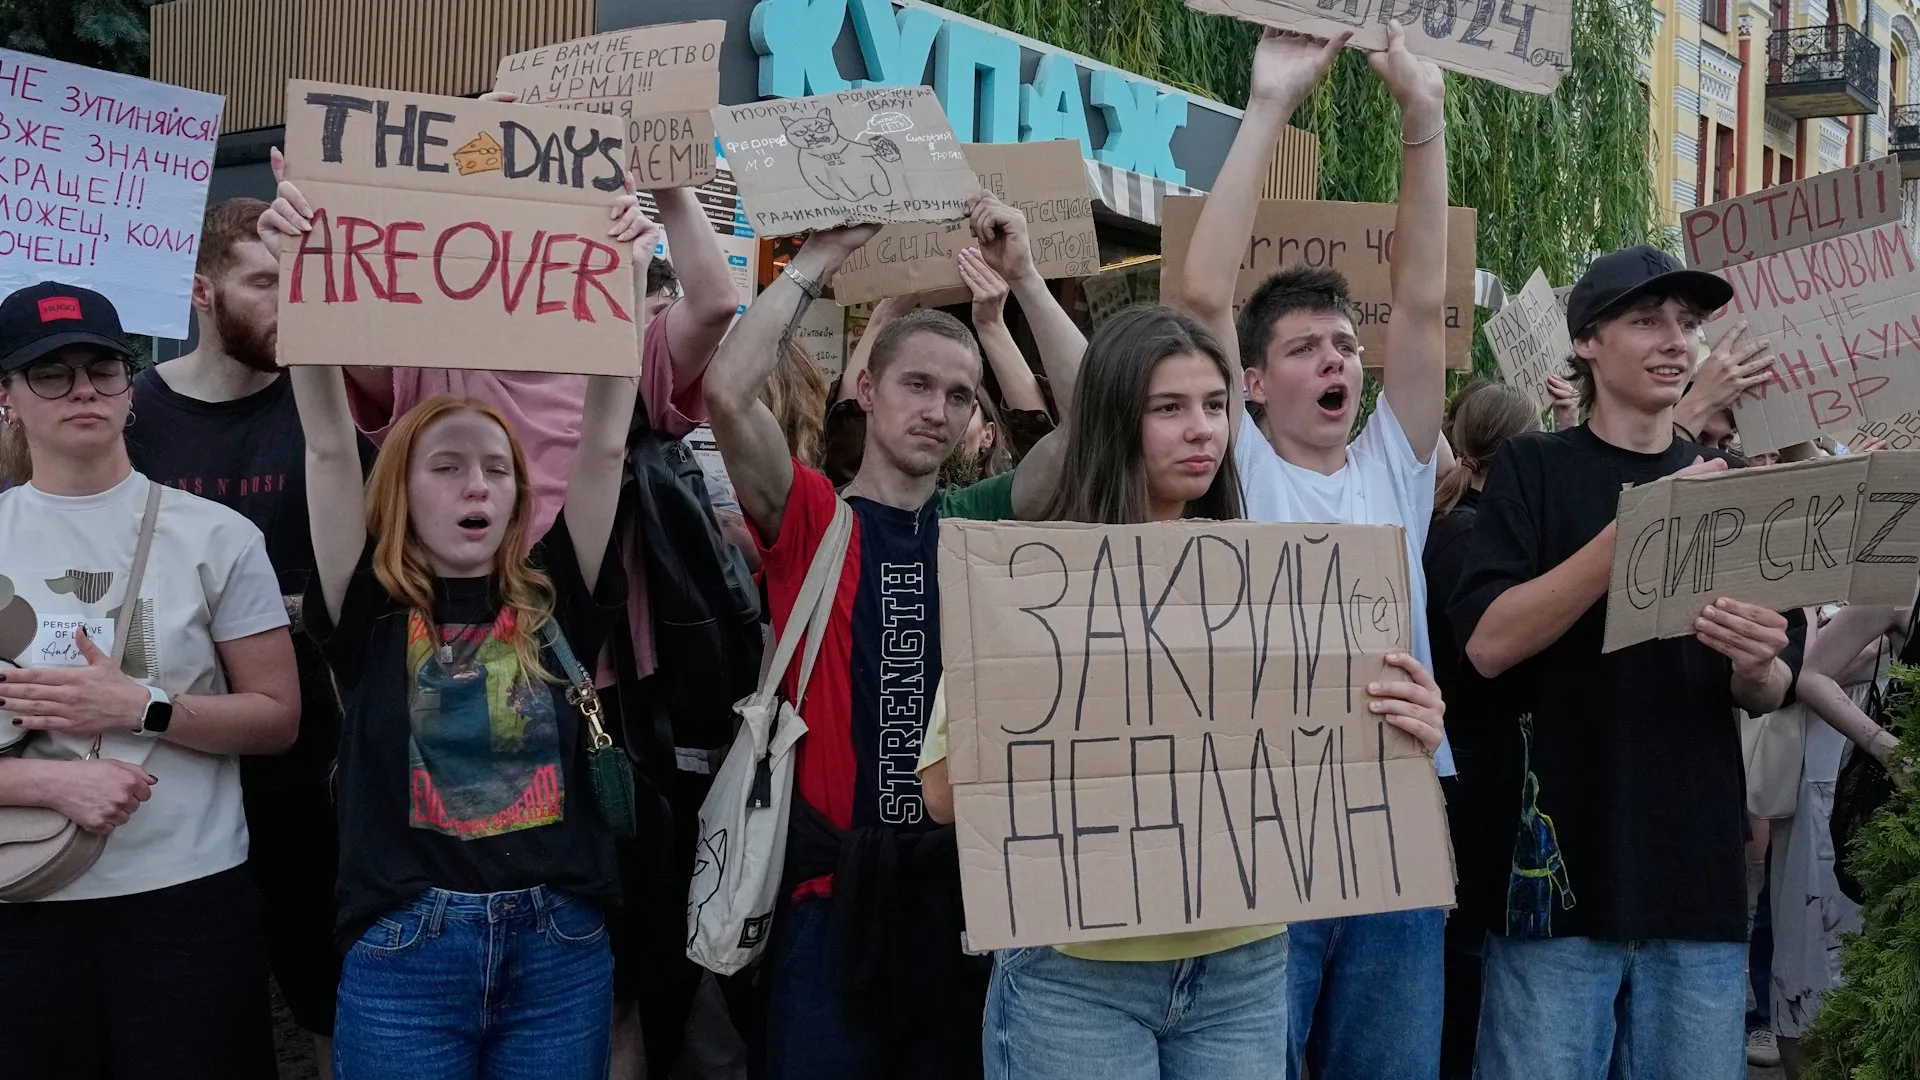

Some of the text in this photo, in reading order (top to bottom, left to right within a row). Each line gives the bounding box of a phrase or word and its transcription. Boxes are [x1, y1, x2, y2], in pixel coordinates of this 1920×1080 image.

[509, 35, 632, 72] ЦЕ ВАМ НЕ
[551, 43, 716, 80] МІНІСТЕРСТВО
[60, 85, 219, 142] ЗУПИНЯЙСЯ!
[750, 0, 1187, 185] КУПАЖ
[306, 92, 624, 193] THE DAYS
[629, 117, 694, 143] ОРОВА
[85, 134, 210, 182] ЗНАЧНО
[629, 143, 708, 183] АЄМ!!!
[127, 220, 195, 255] КОЛИ
[1685, 158, 1892, 266] РОТАЦІЇ
[289, 208, 633, 323] ARE OVER
[1239, 234, 1347, 270] rror
[1707, 221, 1915, 322] ІЙСЬКОВИМ
[1819, 293, 1866, 326] НЕ
[1808, 376, 1890, 430] ВР
[55, 630, 68, 639] OF
[879, 561, 925, 825] STRENGTH
[1002, 721, 1402, 938] ДЕДЛАЙН
